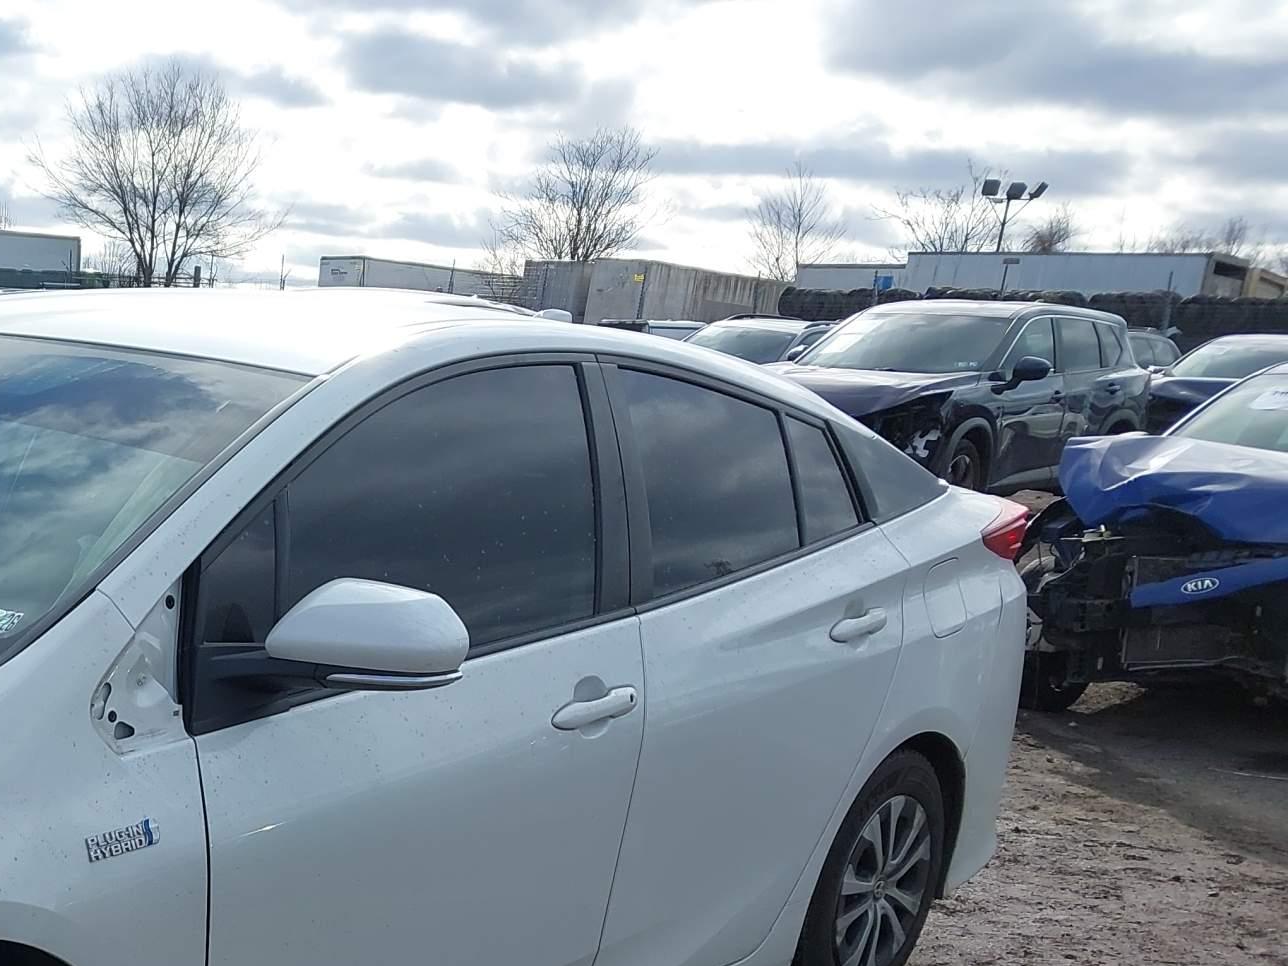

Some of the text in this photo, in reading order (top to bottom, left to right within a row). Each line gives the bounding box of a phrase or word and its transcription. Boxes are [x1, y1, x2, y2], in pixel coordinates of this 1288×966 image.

[1187, 580, 1213, 592] KIA
[87, 824, 143, 848] PLUG-IN
[89, 837, 147, 862] HYBRID
